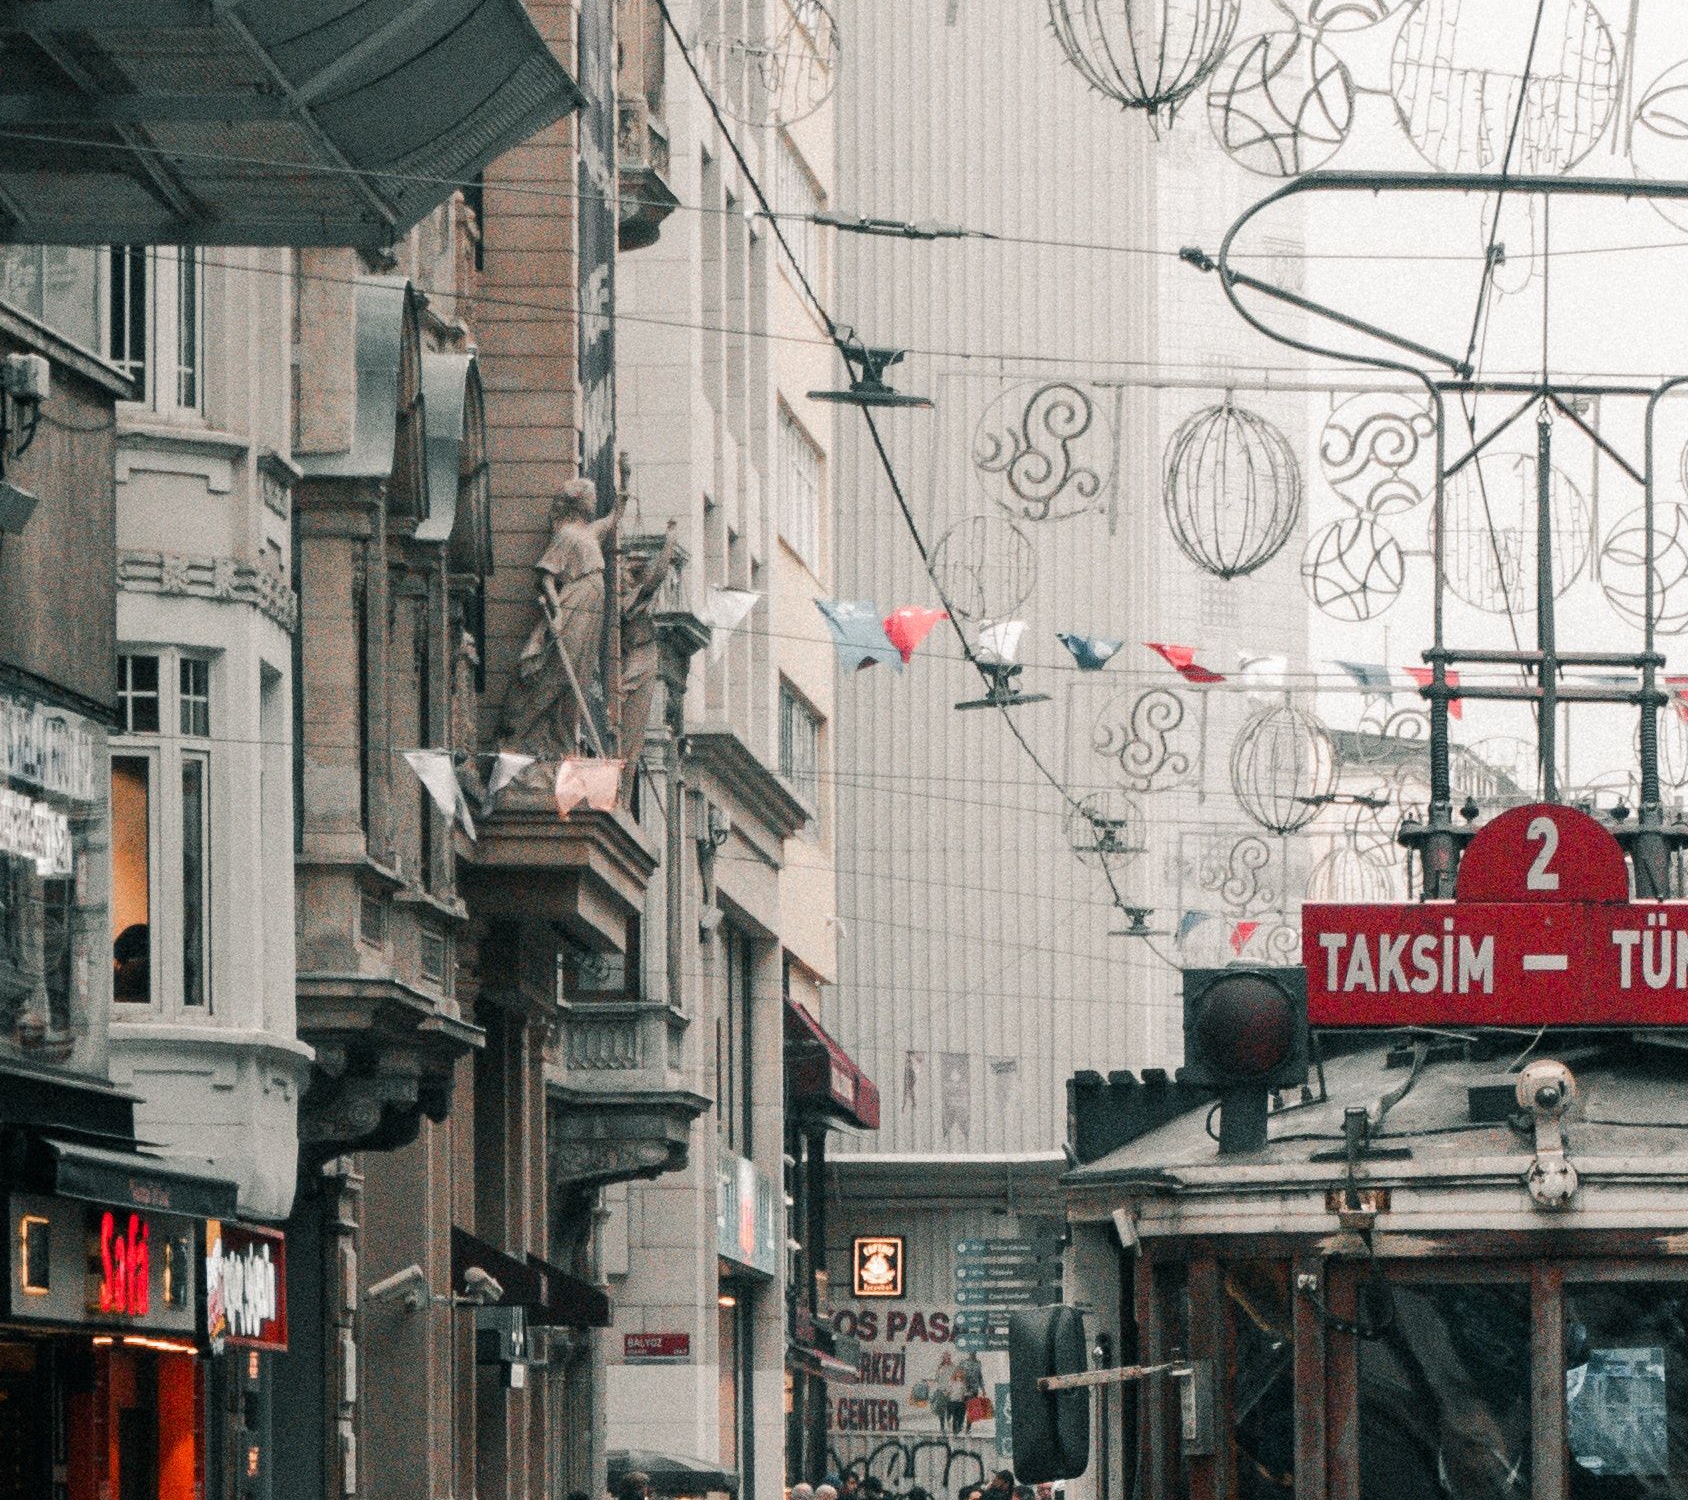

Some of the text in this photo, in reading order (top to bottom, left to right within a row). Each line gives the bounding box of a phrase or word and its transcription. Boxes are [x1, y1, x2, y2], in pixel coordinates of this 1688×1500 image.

[1526, 817, 1560, 890] 2
[1319, 917, 1495, 993] TAKSİM
[837, 1398, 900, 1431] CENTER
